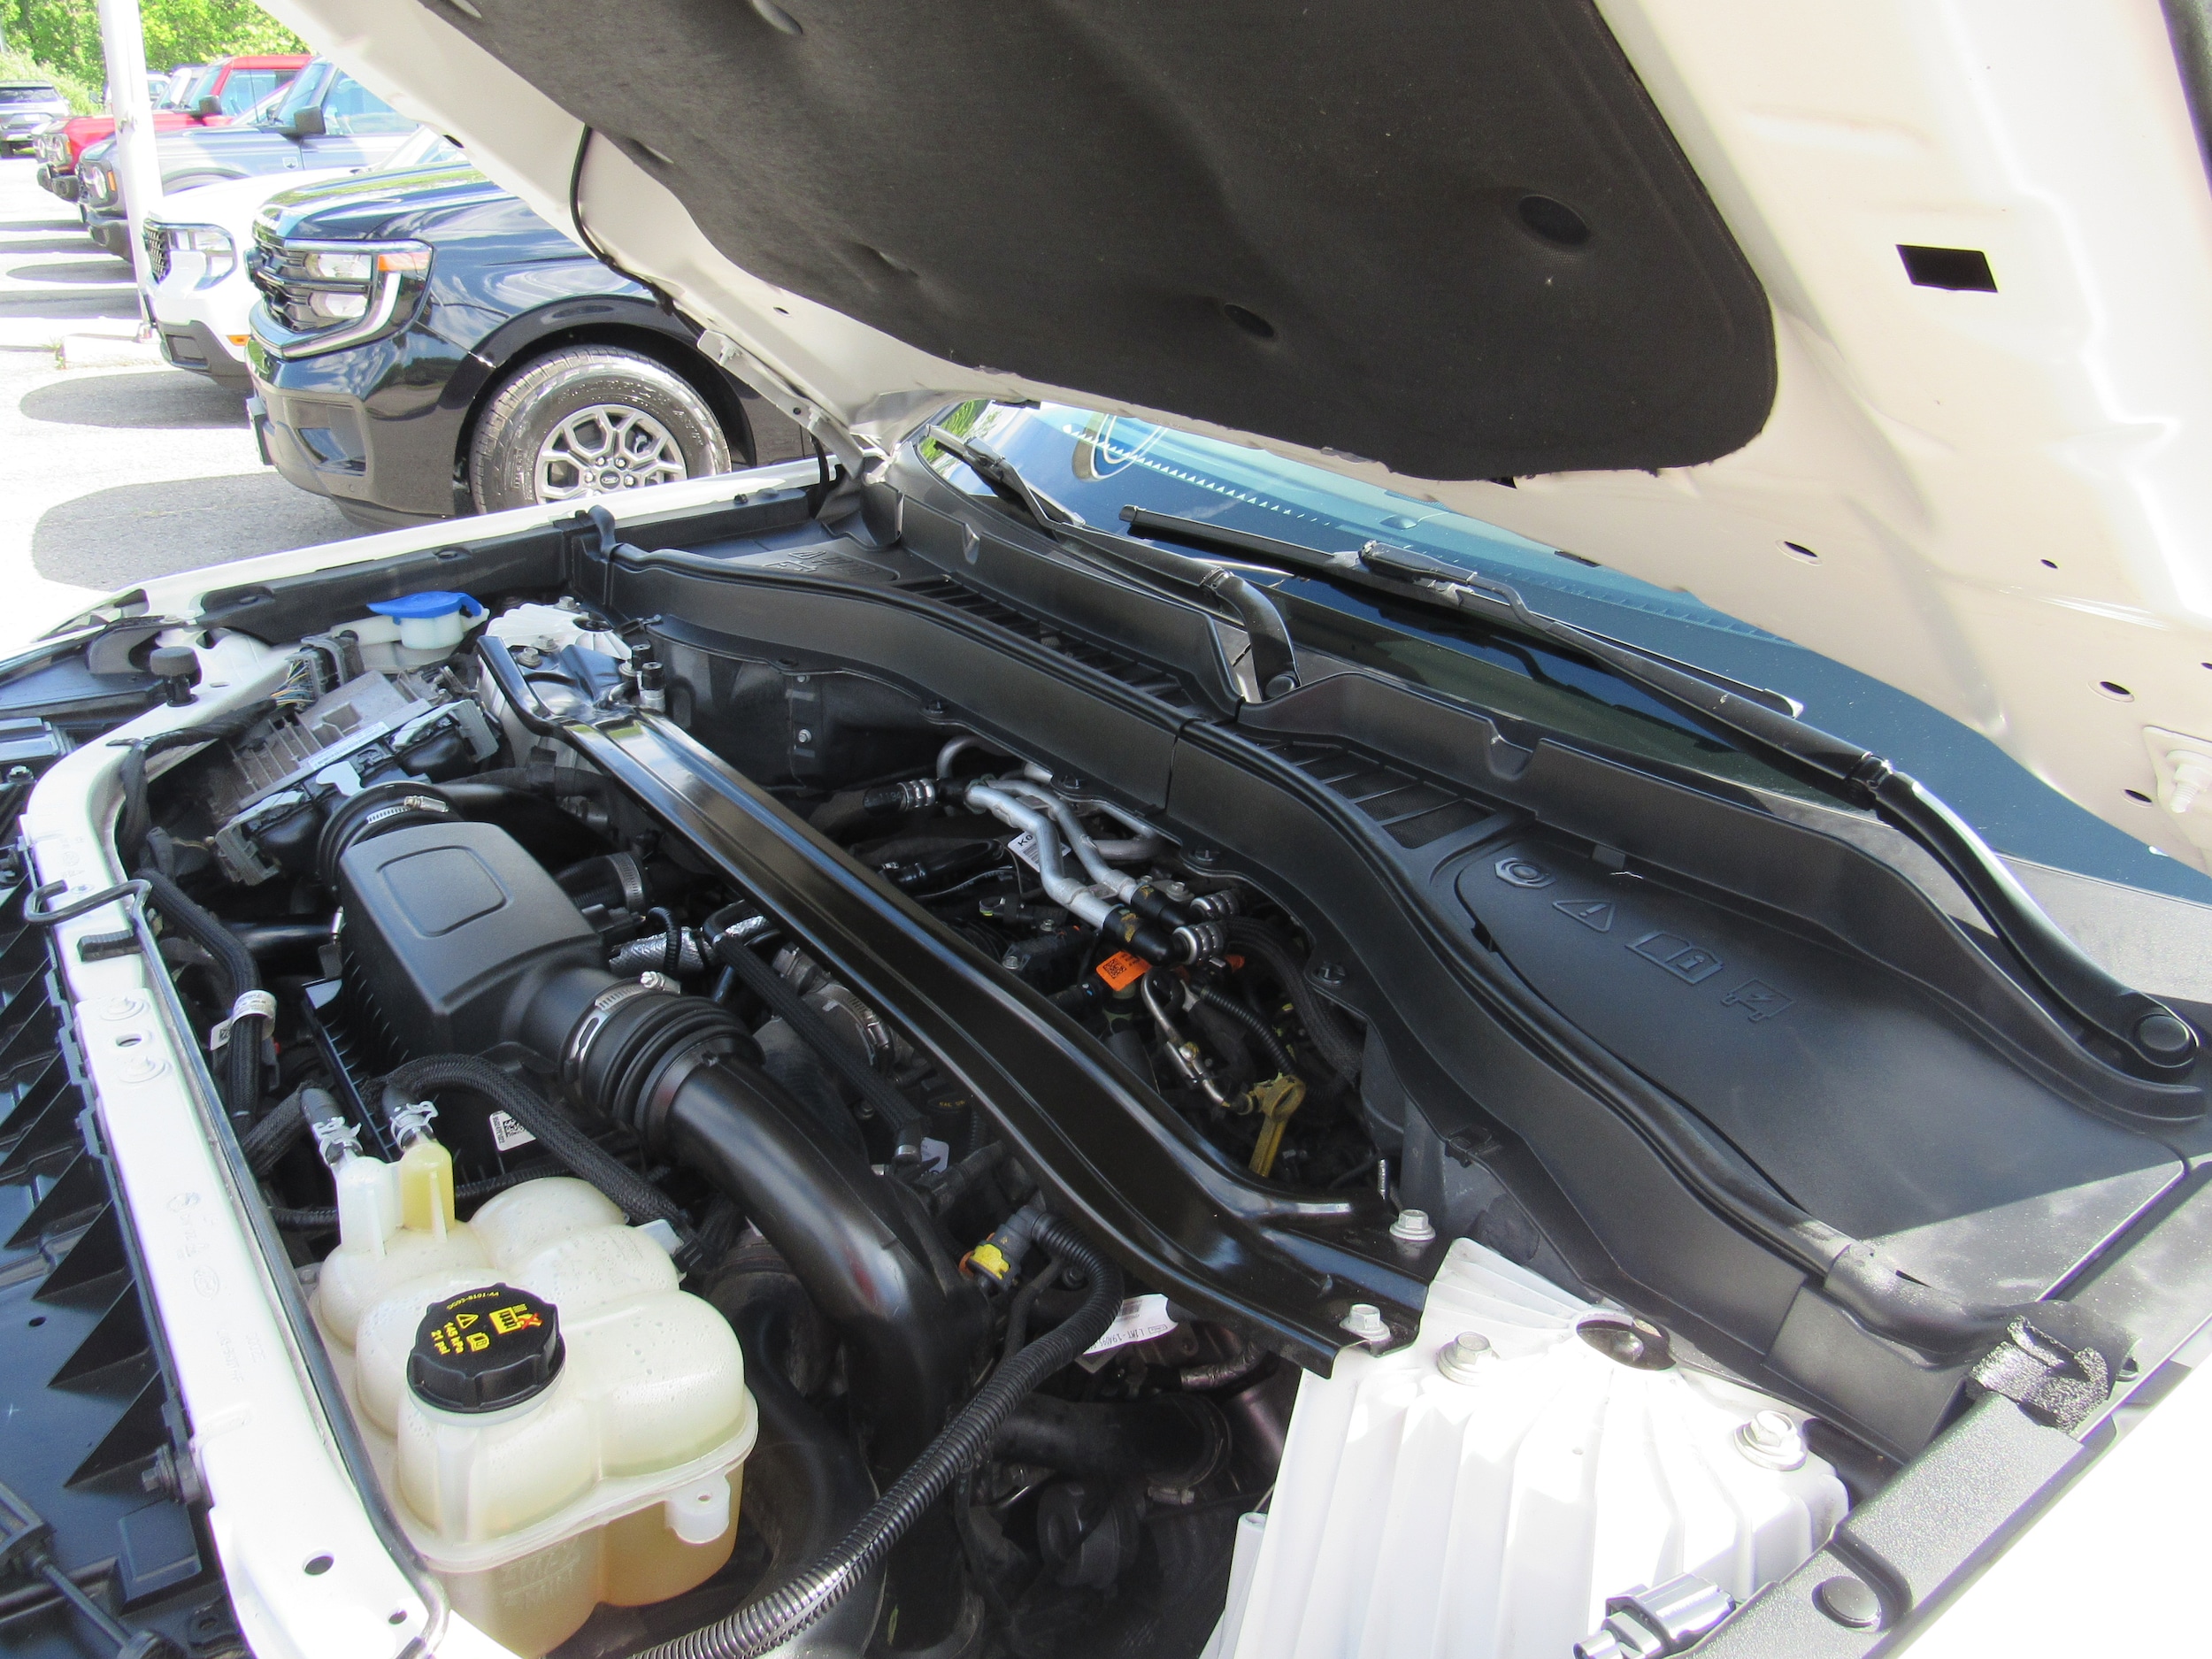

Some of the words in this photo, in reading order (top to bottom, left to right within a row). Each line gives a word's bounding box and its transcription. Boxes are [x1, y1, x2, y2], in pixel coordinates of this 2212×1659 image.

[431, 1330, 443, 1340] 21
[443, 1322, 458, 1338] 145
[434, 1340, 451, 1355] psi
